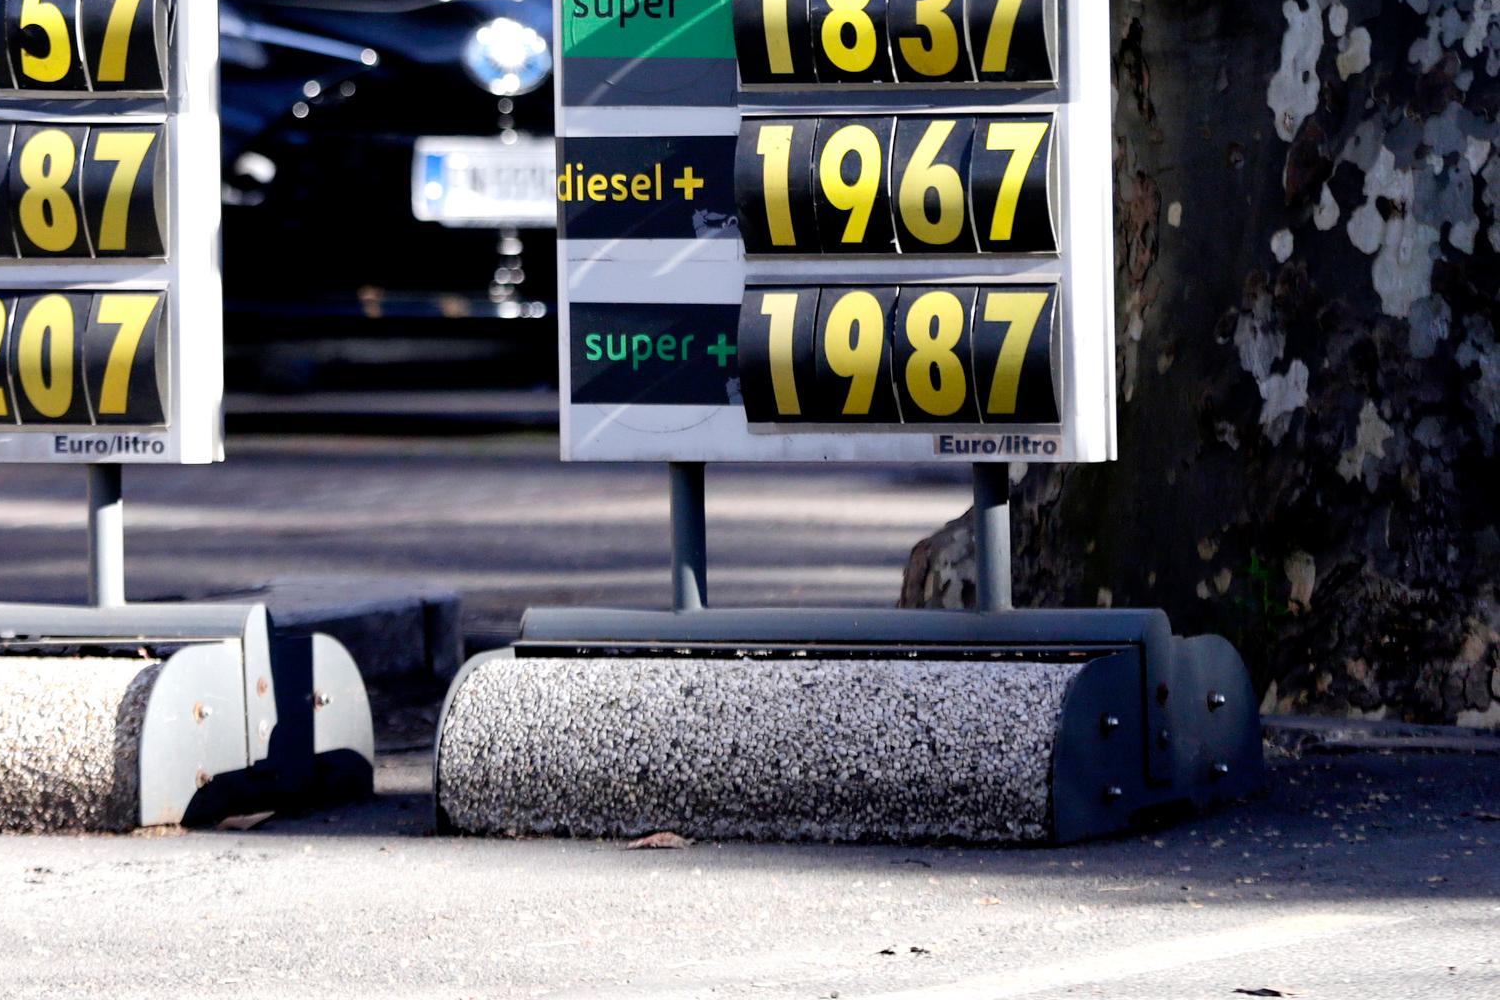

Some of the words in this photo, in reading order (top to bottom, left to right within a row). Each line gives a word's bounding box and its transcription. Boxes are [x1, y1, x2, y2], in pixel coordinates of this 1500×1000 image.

[757, 118, 1049, 247] 1967
[760, 288, 1049, 417] 1987
[53, 434, 166, 456] Euro/litro
[938, 434, 1058, 456] Euro/litro
